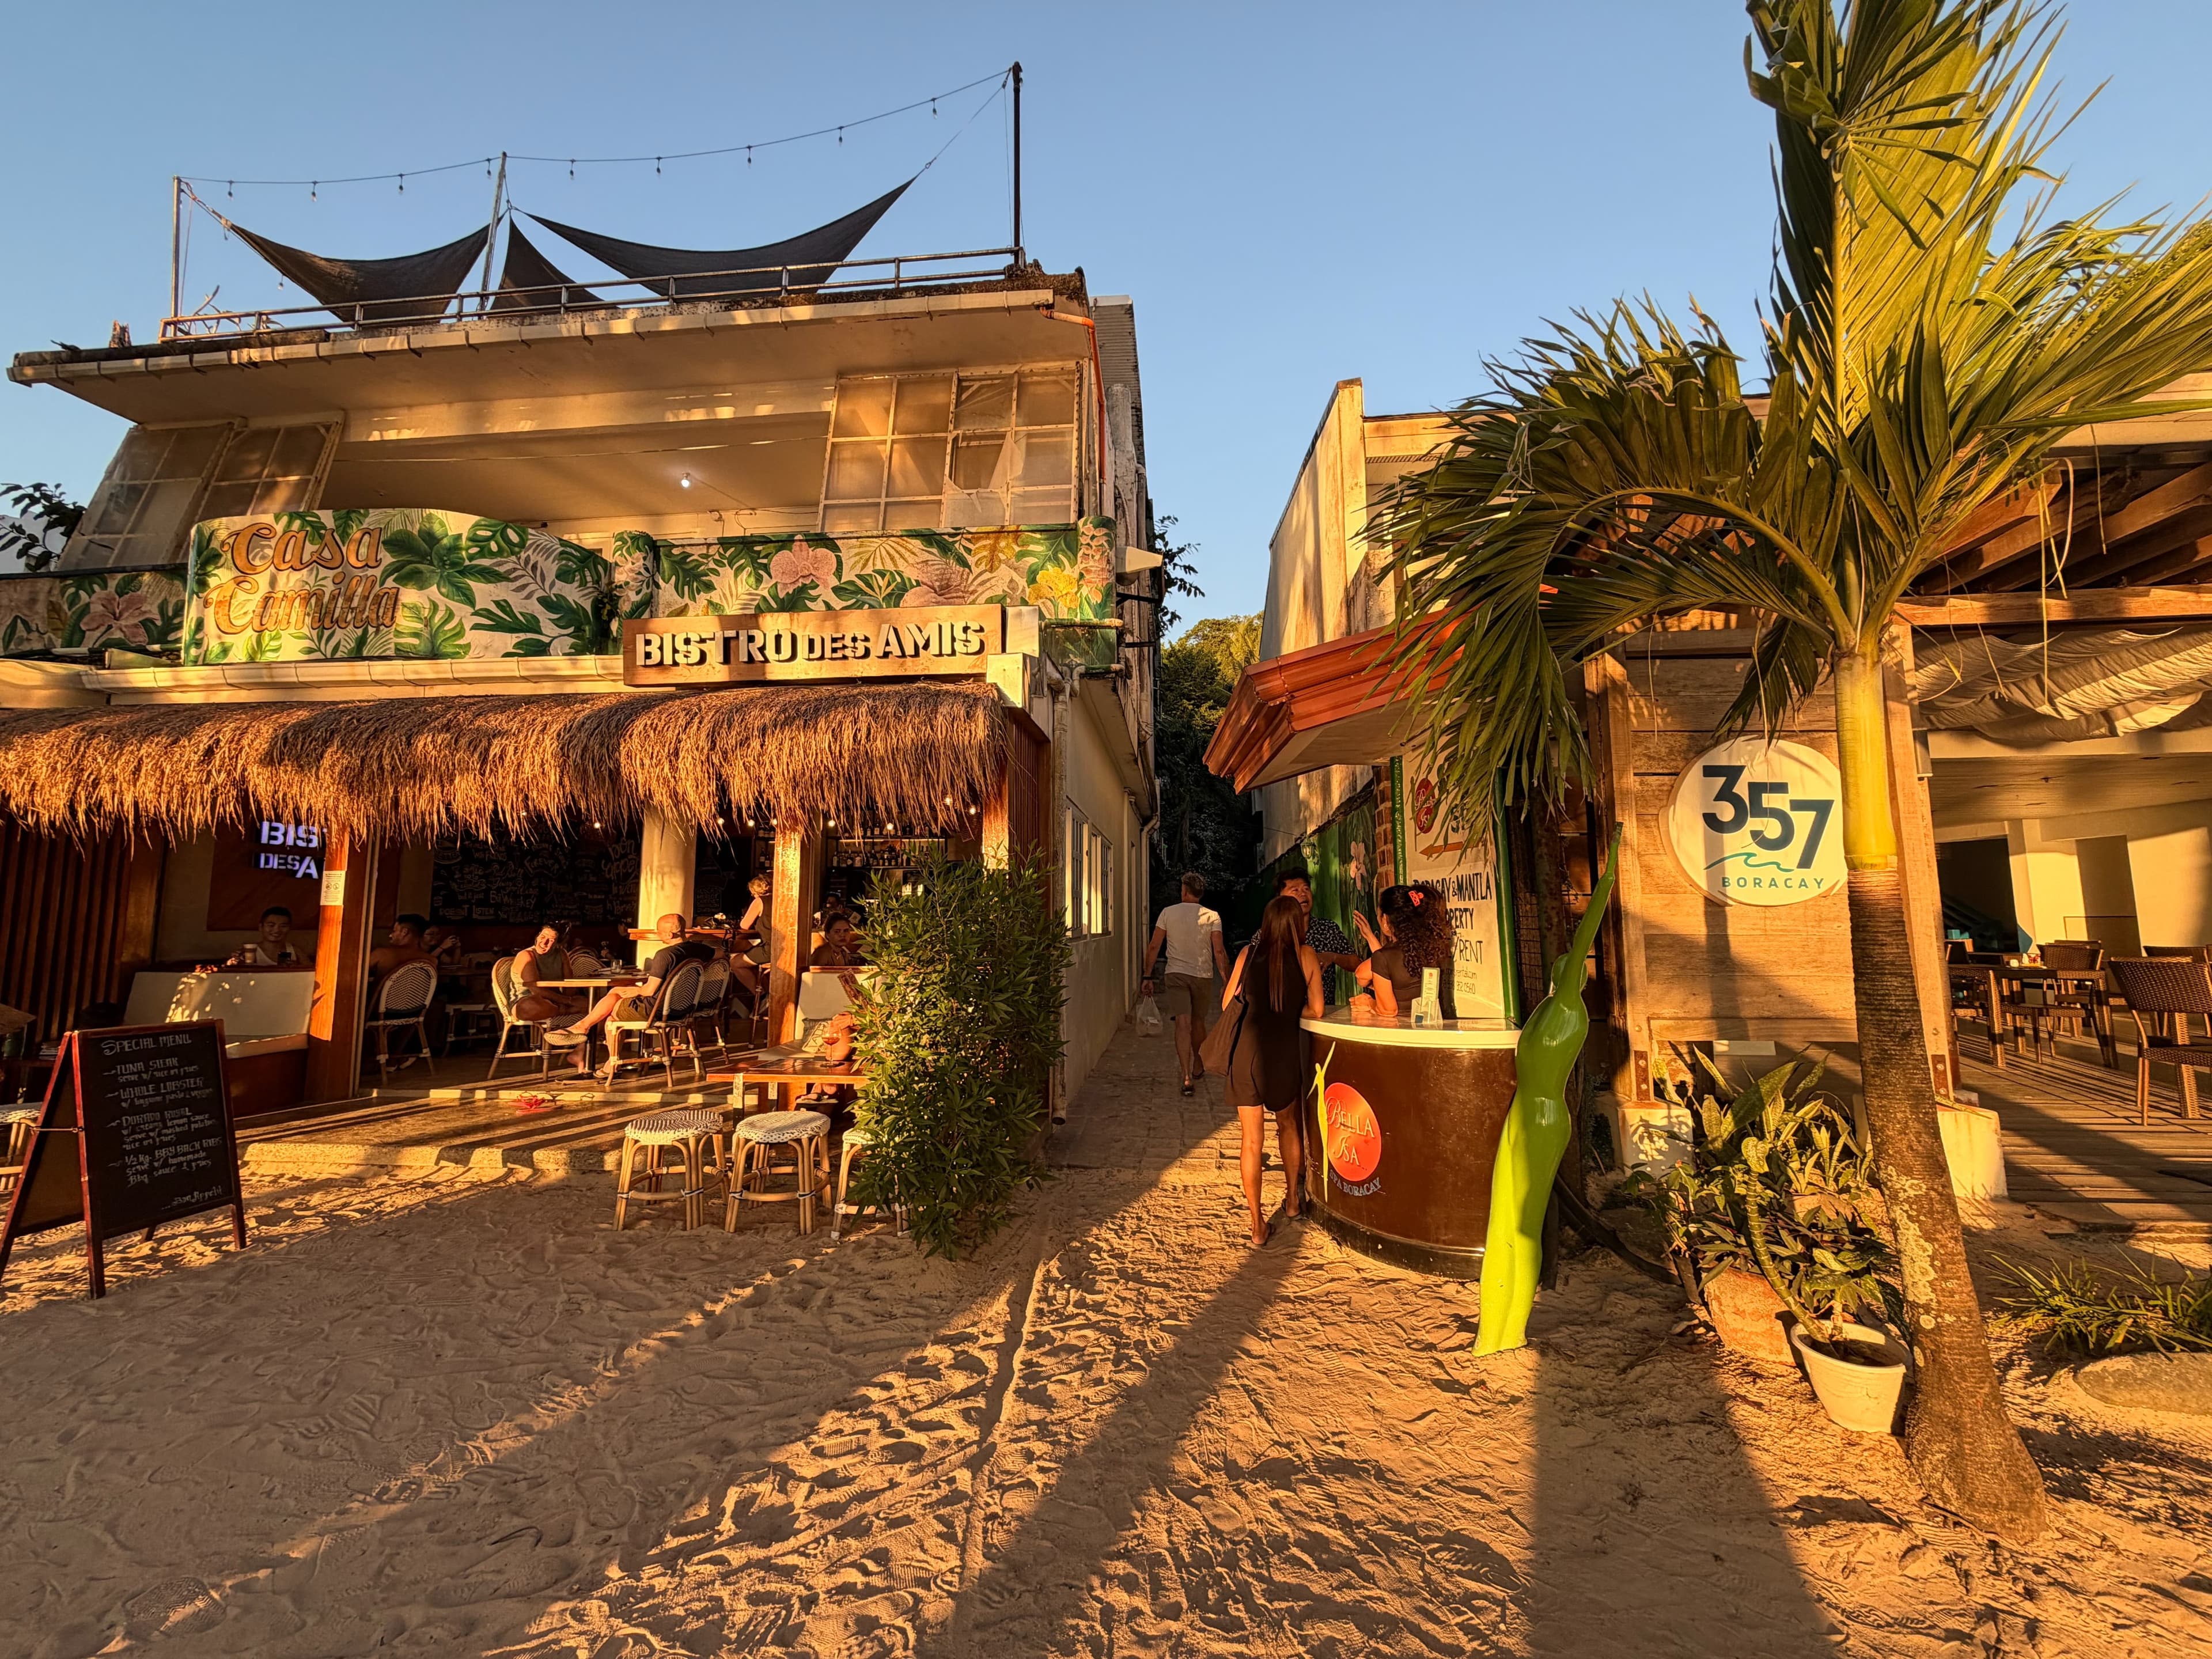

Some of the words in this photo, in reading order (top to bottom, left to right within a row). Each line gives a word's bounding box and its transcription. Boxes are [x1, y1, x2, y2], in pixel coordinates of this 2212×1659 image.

[221, 522, 382, 575] Casa
[203, 572, 400, 635] Camilla
[635, 628, 796, 666] BISTRO
[802, 632, 869, 660] DES
[876, 620, 985, 657] AMIS
[1702, 764, 1835, 869] 357
[261, 821, 323, 848] BIS
[1456, 871, 1493, 902] MANILA
[1721, 876, 1824, 889] BORACAY
[101, 1037, 157, 1055] SPECIAL
[159, 1034, 192, 1047] MENU
[115, 1062, 145, 1074] TUNA
[149, 1057, 179, 1070] STEAK
[120, 1084, 157, 1099] WHOLE
[160, 1077, 204, 1093] LOBSTER
[1329, 1169, 1342, 1190] SPA
[1342, 1177, 1381, 1196] BORACAY
